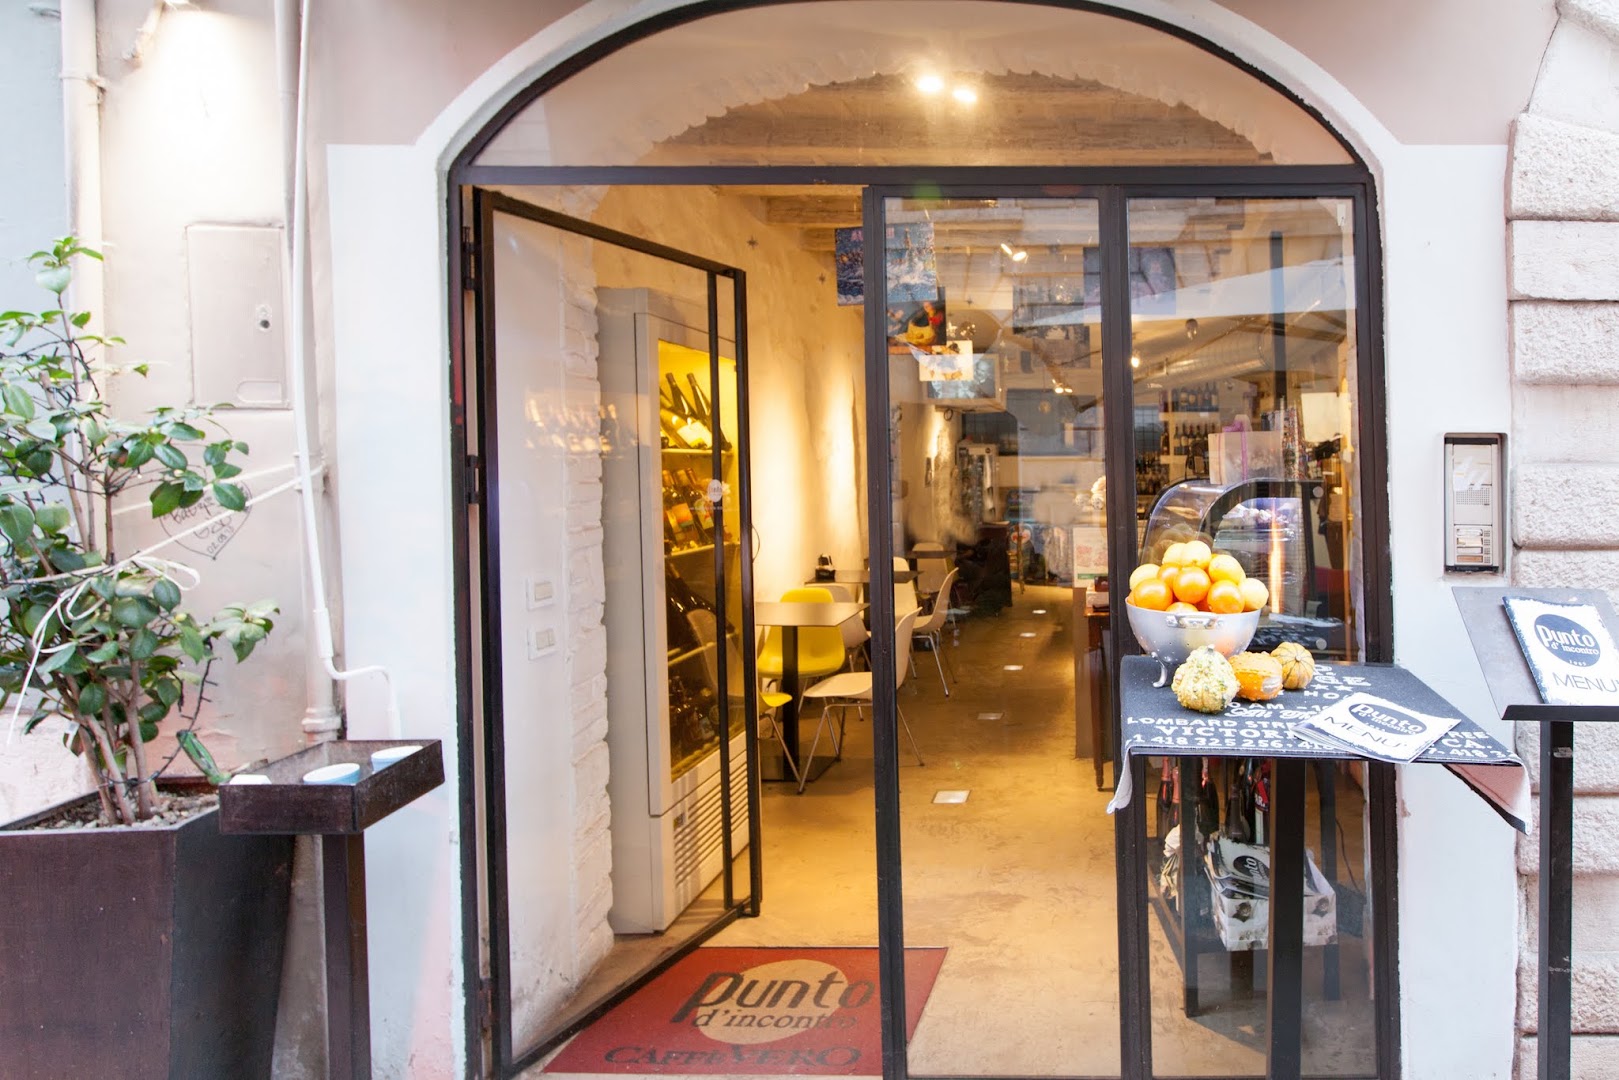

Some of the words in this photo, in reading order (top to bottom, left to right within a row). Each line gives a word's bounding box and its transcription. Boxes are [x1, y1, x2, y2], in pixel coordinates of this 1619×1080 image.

[1248, 702, 1285, 710] AM
[1127, 716, 1238, 727] LOMBARD
[1150, 736, 1189, 746] 418
[1194, 737, 1237, 747] 325
